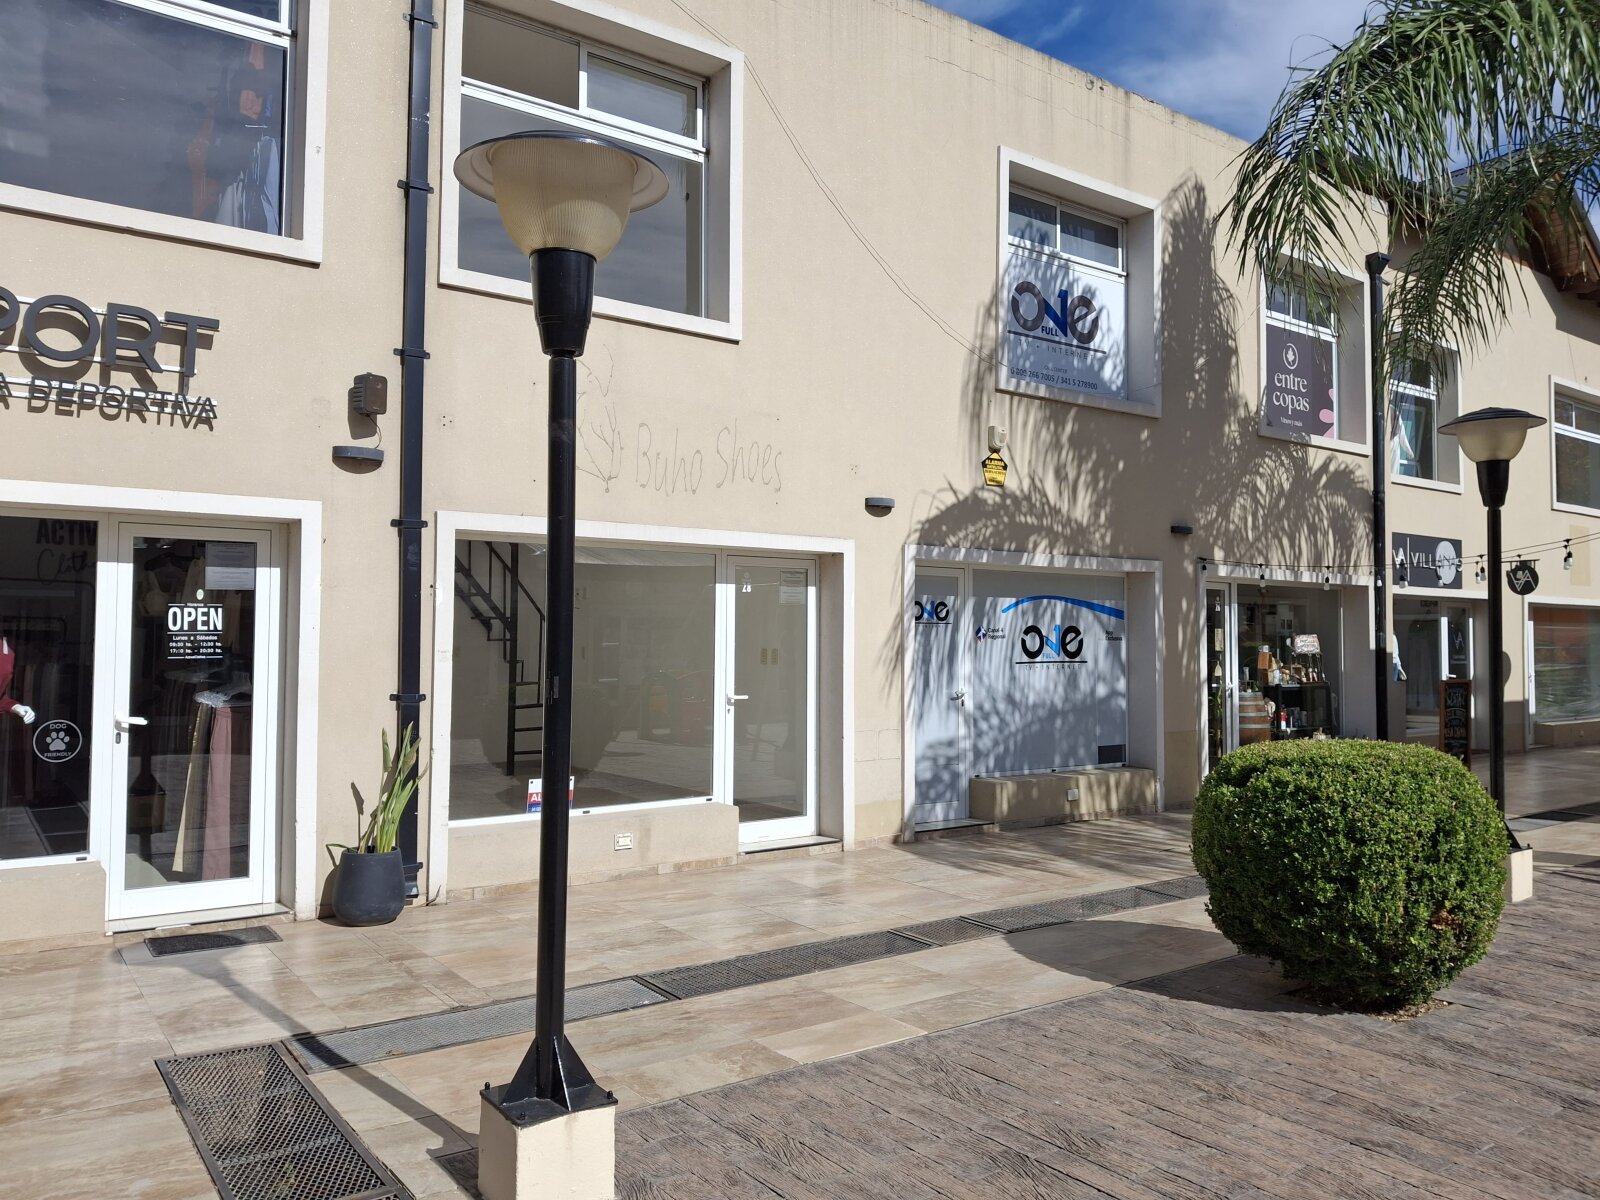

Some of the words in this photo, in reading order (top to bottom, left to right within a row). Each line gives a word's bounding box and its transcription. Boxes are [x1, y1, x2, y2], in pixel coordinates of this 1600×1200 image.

[1041, 325, 1059, 337] FULL
[1047, 345, 1095, 360] INTERNET
[1028, 370, 1040, 379] 266
[1041, 372, 1055, 382] 7005
[1061, 377, 1071, 385] 341
[1077, 380, 1098, 390] 278900
[1274, 372, 1307, 392] entre
[31, 375, 218, 419] DEPORTIVA
[1272, 391, 1310, 415] copas
[716, 417, 782, 493] Shoes
[985, 459, 1005, 467] ALARMA
[168, 607, 223, 631] OPEN
